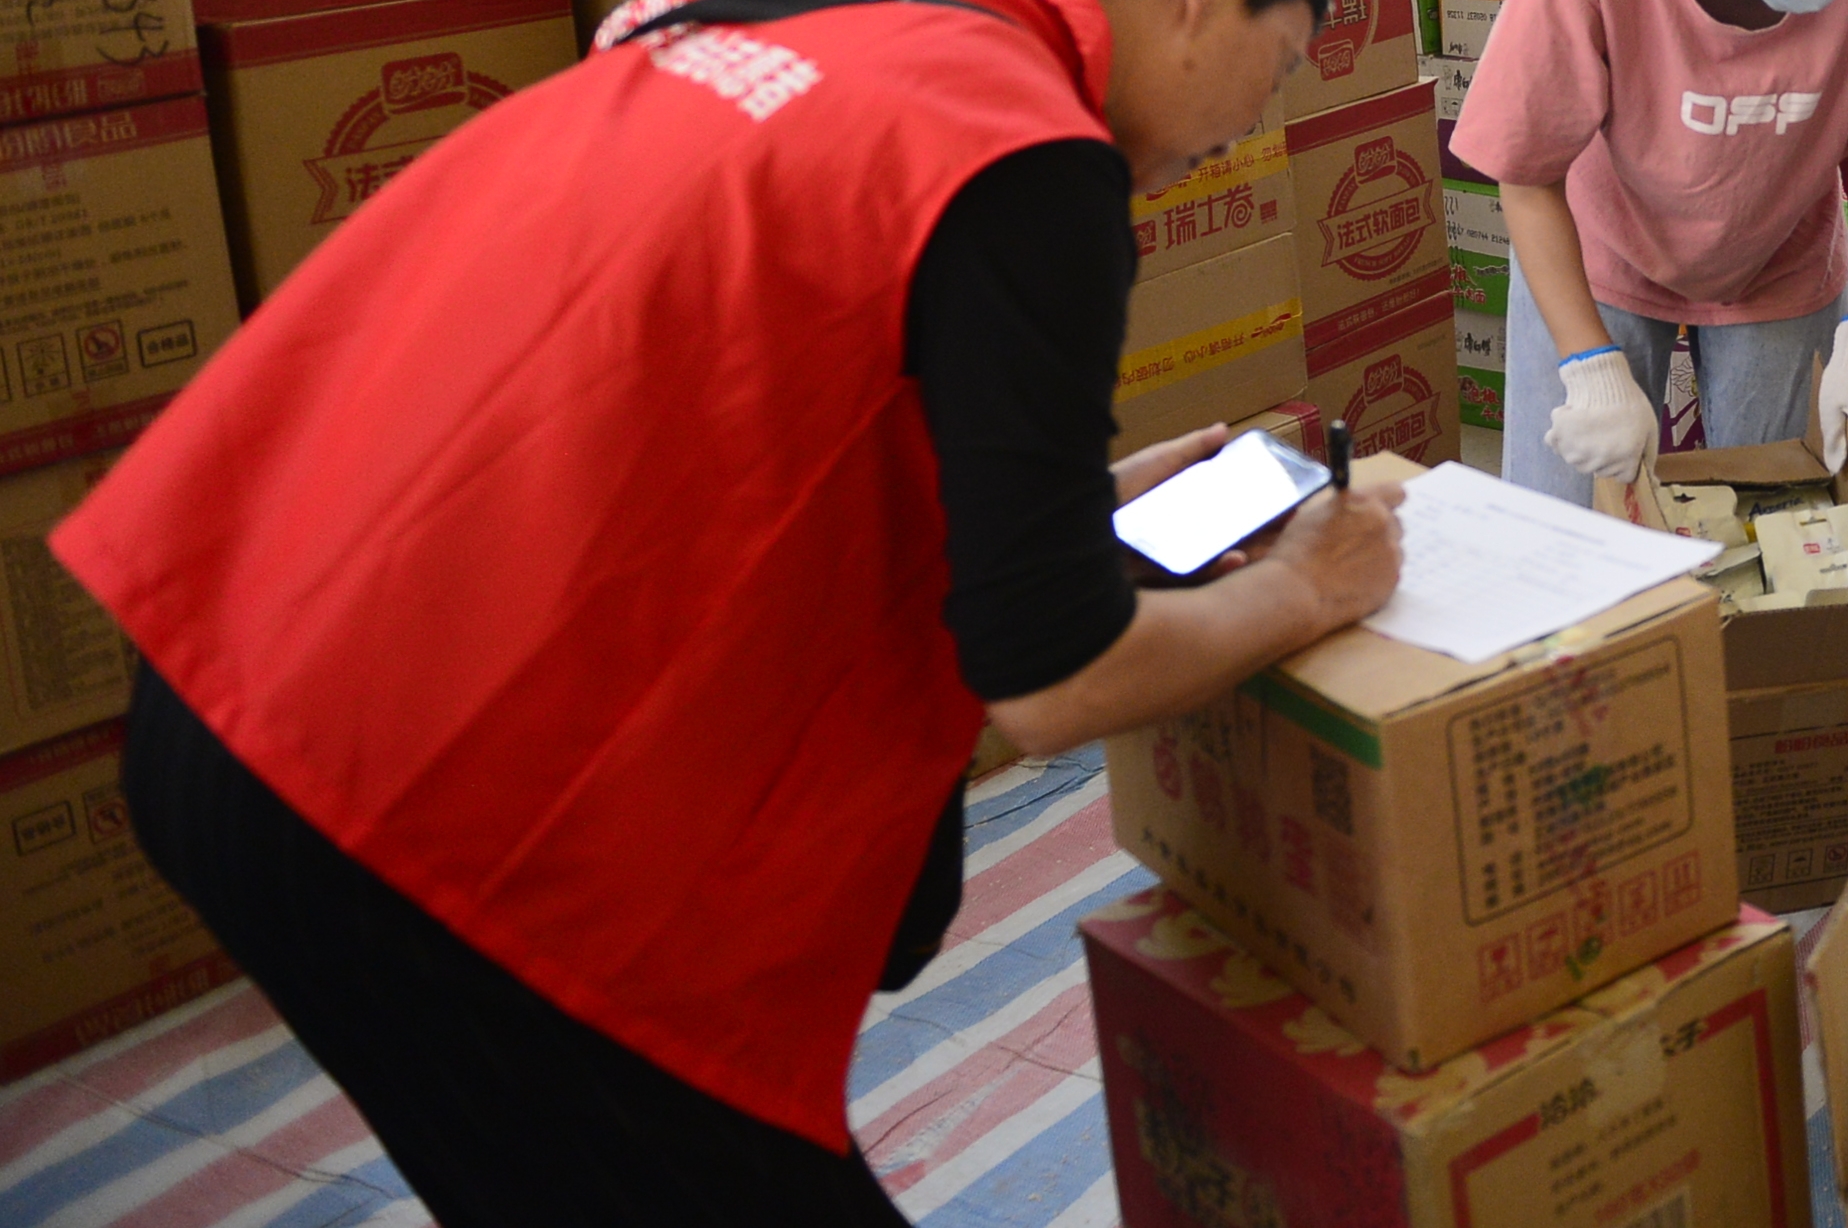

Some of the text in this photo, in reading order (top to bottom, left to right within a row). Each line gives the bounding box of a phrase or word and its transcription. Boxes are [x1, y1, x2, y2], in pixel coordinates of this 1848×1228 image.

[1680, 90, 1823, 137] OFF
[1197, 153, 1255, 183] 开箱请小心
[1164, 183, 1254, 250] 瑞士卷
[1336, 198, 1421, 248] 法式软面包
[1182, 332, 1246, 363] 开箱请小心
[1463, 332, 1493, 357] 康师傅
